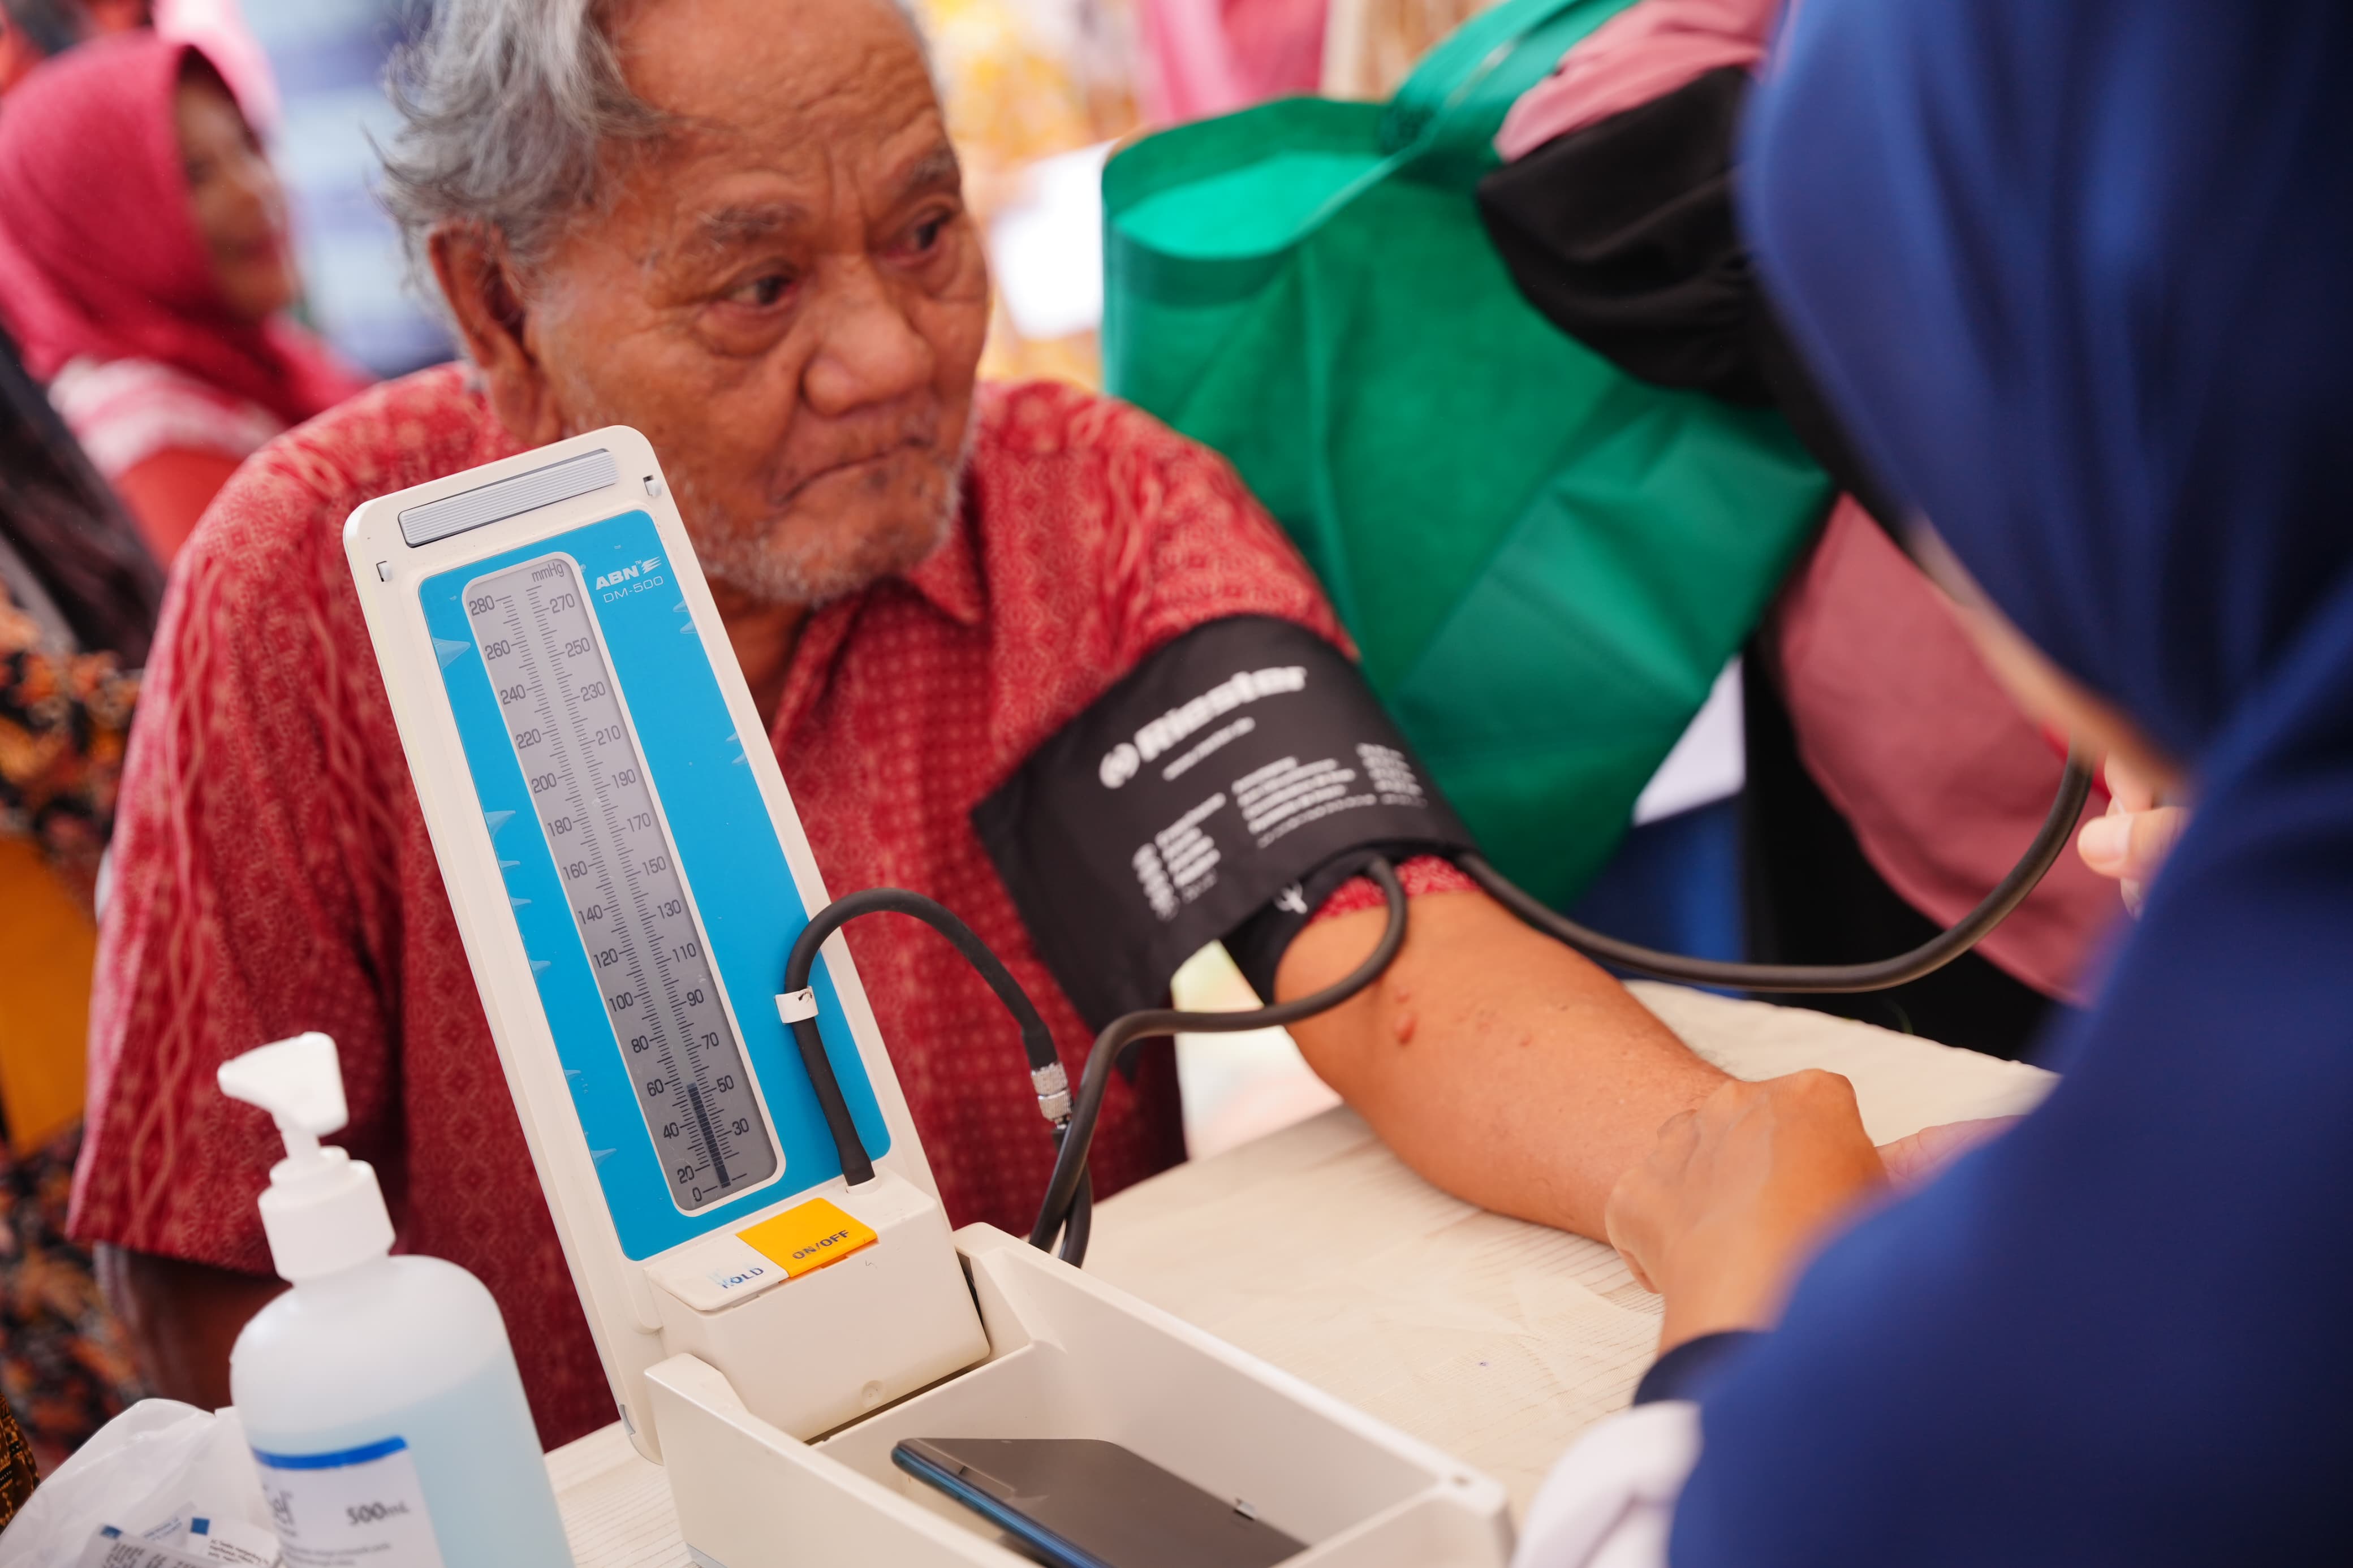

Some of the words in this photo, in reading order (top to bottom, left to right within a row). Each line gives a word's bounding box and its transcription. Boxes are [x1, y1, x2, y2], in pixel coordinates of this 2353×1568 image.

[532, 562, 564, 582] mmHg
[596, 565, 639, 590] ABN
[603, 576, 664, 603] DM-500
[469, 595, 495, 616] 280
[550, 593, 575, 614] 270
[485, 639, 510, 660] 260
[566, 637, 590, 658] 250
[501, 684, 526, 705] 240
[581, 681, 605, 702] 230
[516, 728, 541, 749] 220
[596, 725, 621, 746] 210
[531, 773, 557, 793] 200
[611, 769, 636, 789] 190
[548, 817, 572, 837] 180
[627, 813, 651, 833] 170
[563, 860, 588, 881] 160
[643, 856, 666, 876] 150
[579, 904, 603, 925] 140
[657, 899, 682, 920] 130
[594, 948, 618, 969] 120
[673, 943, 696, 963] 110
[609, 992, 634, 1012] 100
[687, 988, 704, 1007] 90
[631, 1035, 649, 1053] 80
[701, 1031, 719, 1050] 70
[647, 1078, 664, 1097] 60
[717, 1075, 734, 1093] 50
[663, 1122, 679, 1139] 40
[732, 1118, 749, 1136] 30
[678, 1166, 695, 1183] 20
[692, 1187, 702, 1202] 0
[792, 1229, 850, 1259] ON/OFF
